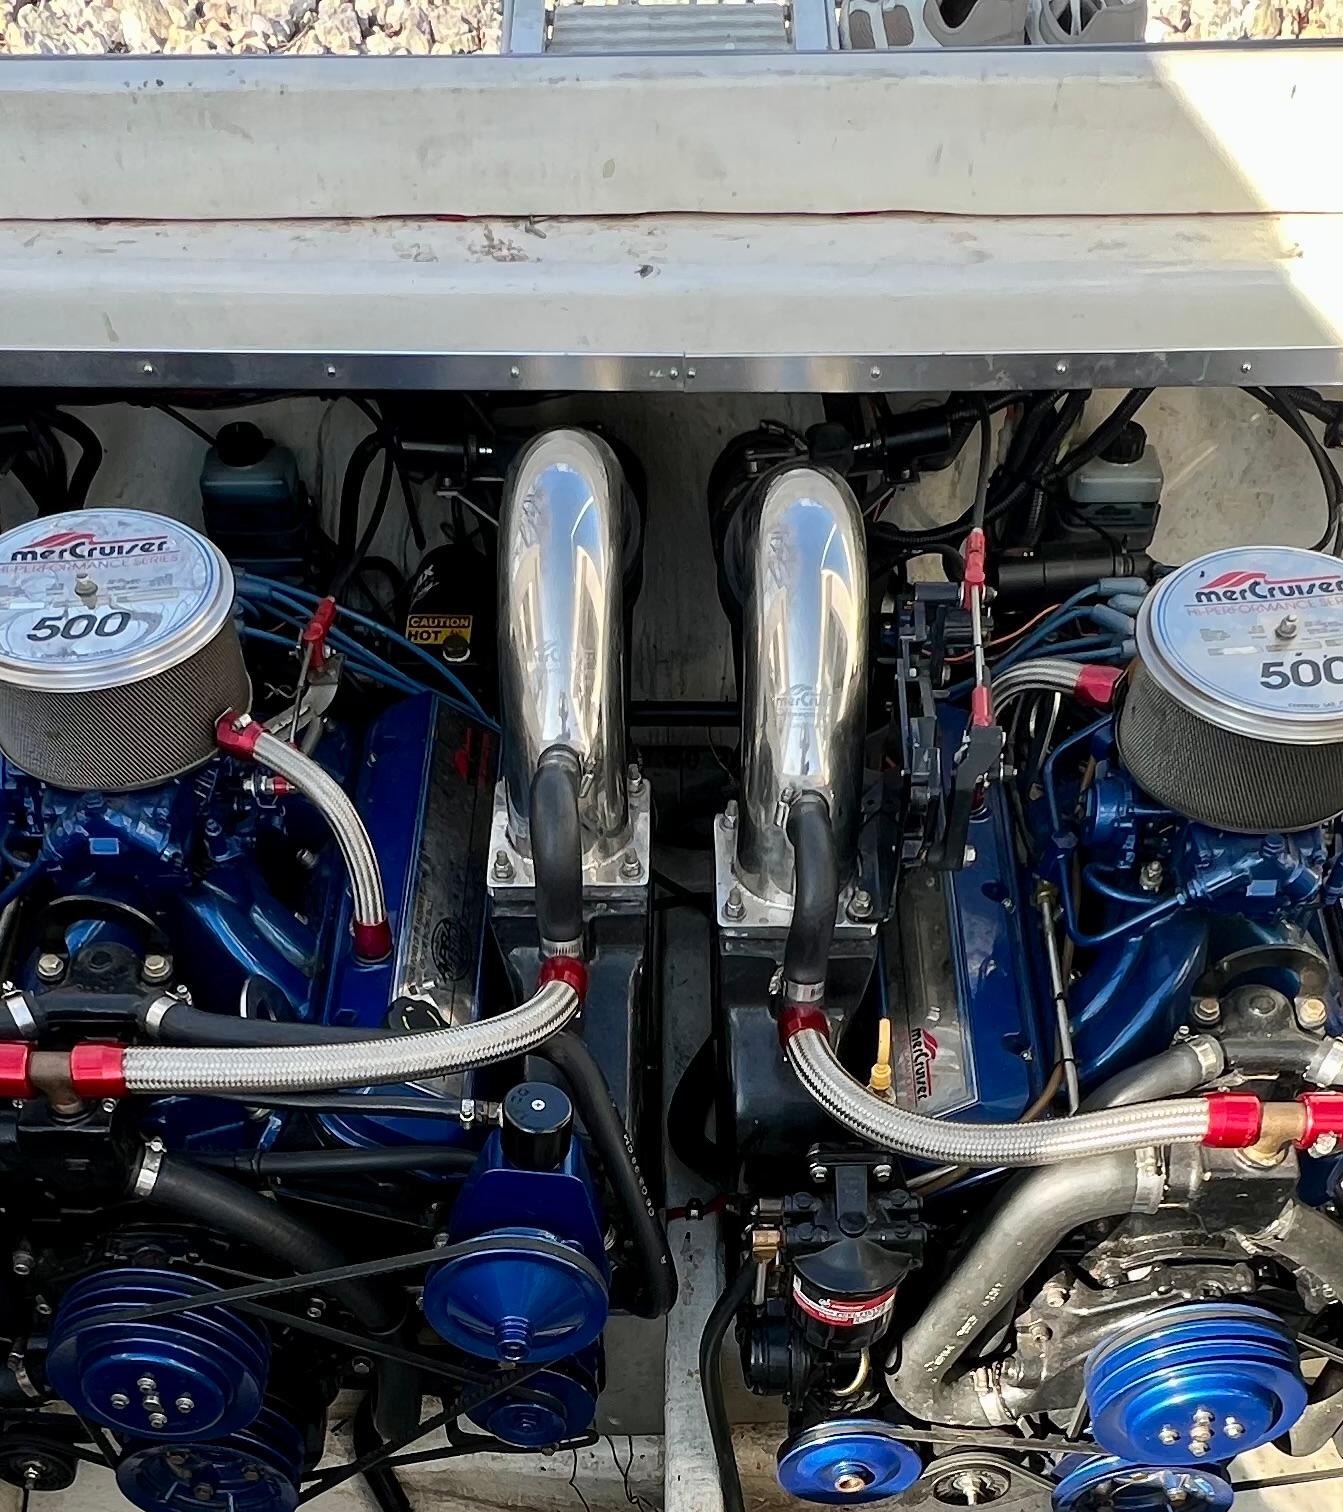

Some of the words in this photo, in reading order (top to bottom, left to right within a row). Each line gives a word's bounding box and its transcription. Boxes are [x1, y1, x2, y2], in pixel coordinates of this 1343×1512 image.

[27, 611, 132, 642] 500
[410, 617, 470, 628] CAUTION
[409, 630, 442, 642] HOT
